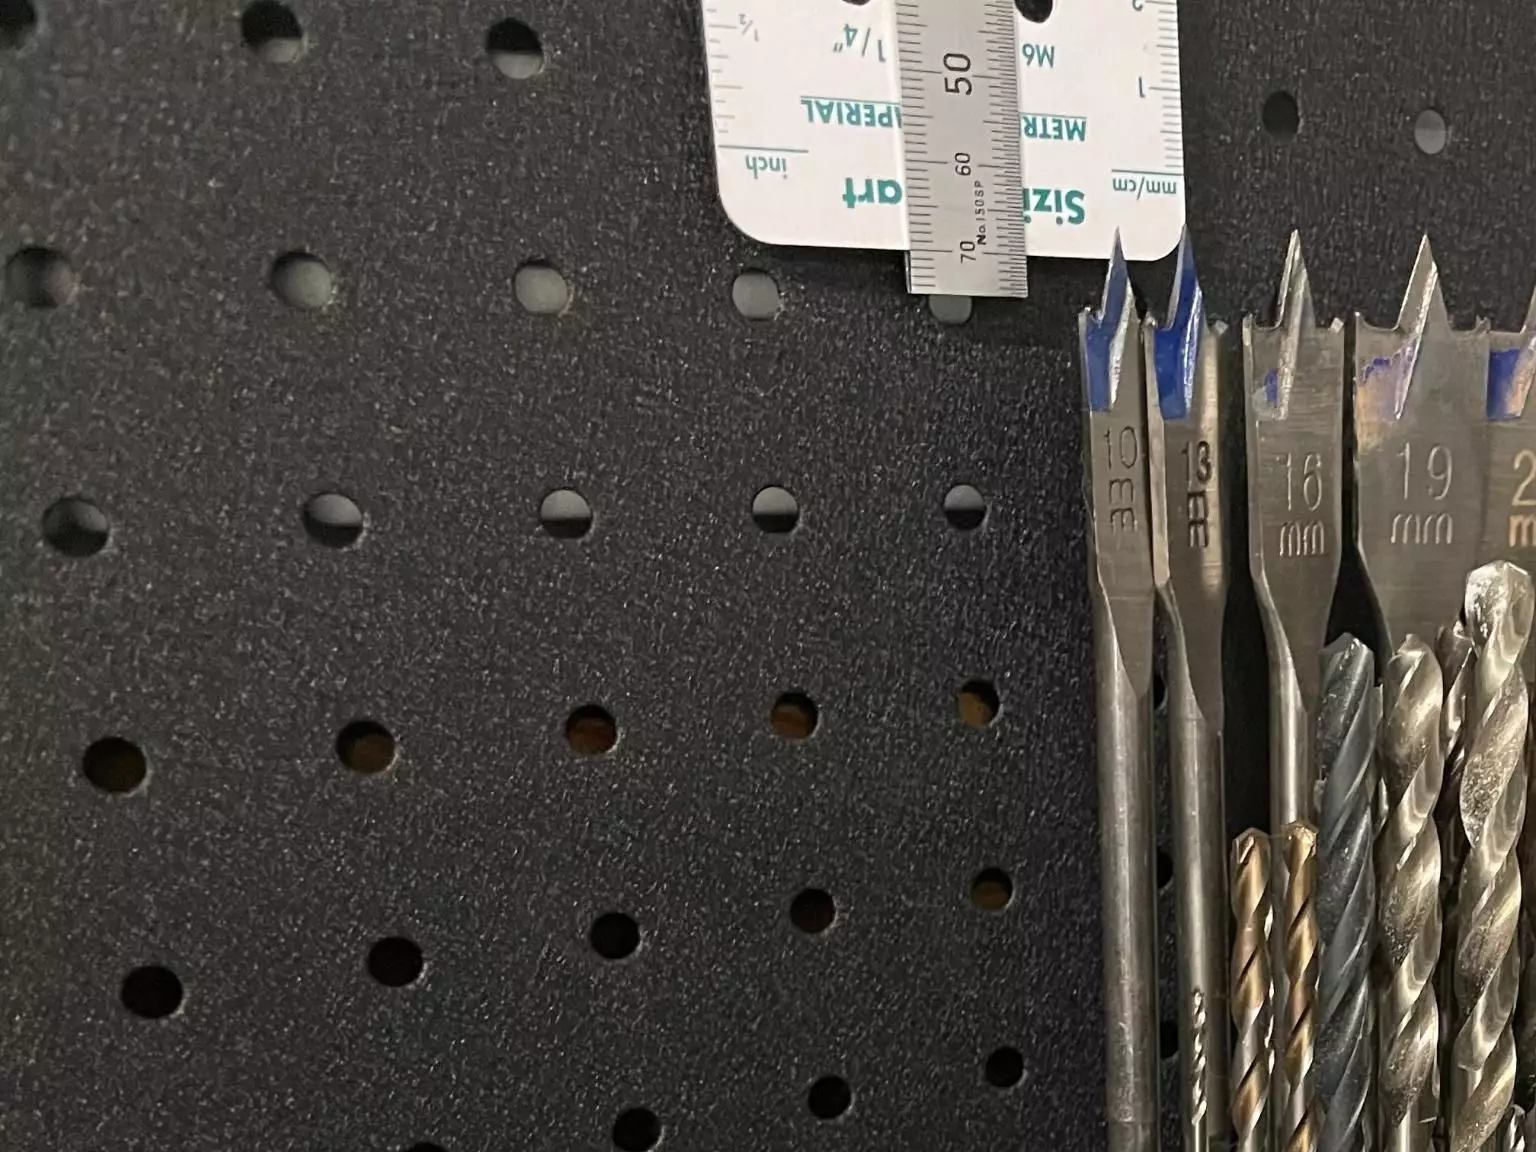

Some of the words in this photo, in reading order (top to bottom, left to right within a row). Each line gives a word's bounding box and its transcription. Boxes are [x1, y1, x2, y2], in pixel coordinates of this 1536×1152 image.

[1022, 43, 1055, 68] M6
[943, 53, 972, 96] 50
[1137, 76, 1146, 98] 1
[745, 154, 788, 180] inch
[954, 152, 971, 176] 60
[842, 177, 903, 209] art
[1112, 177, 1177, 200] mm/cm
[960, 230, 976, 264] 70
[1103, 425, 1138, 470] 10
[1275, 453, 1323, 512] 16
[1397, 442, 1453, 501] 19
[1279, 519, 1325, 557] mm
[1390, 512, 1454, 545] mm
